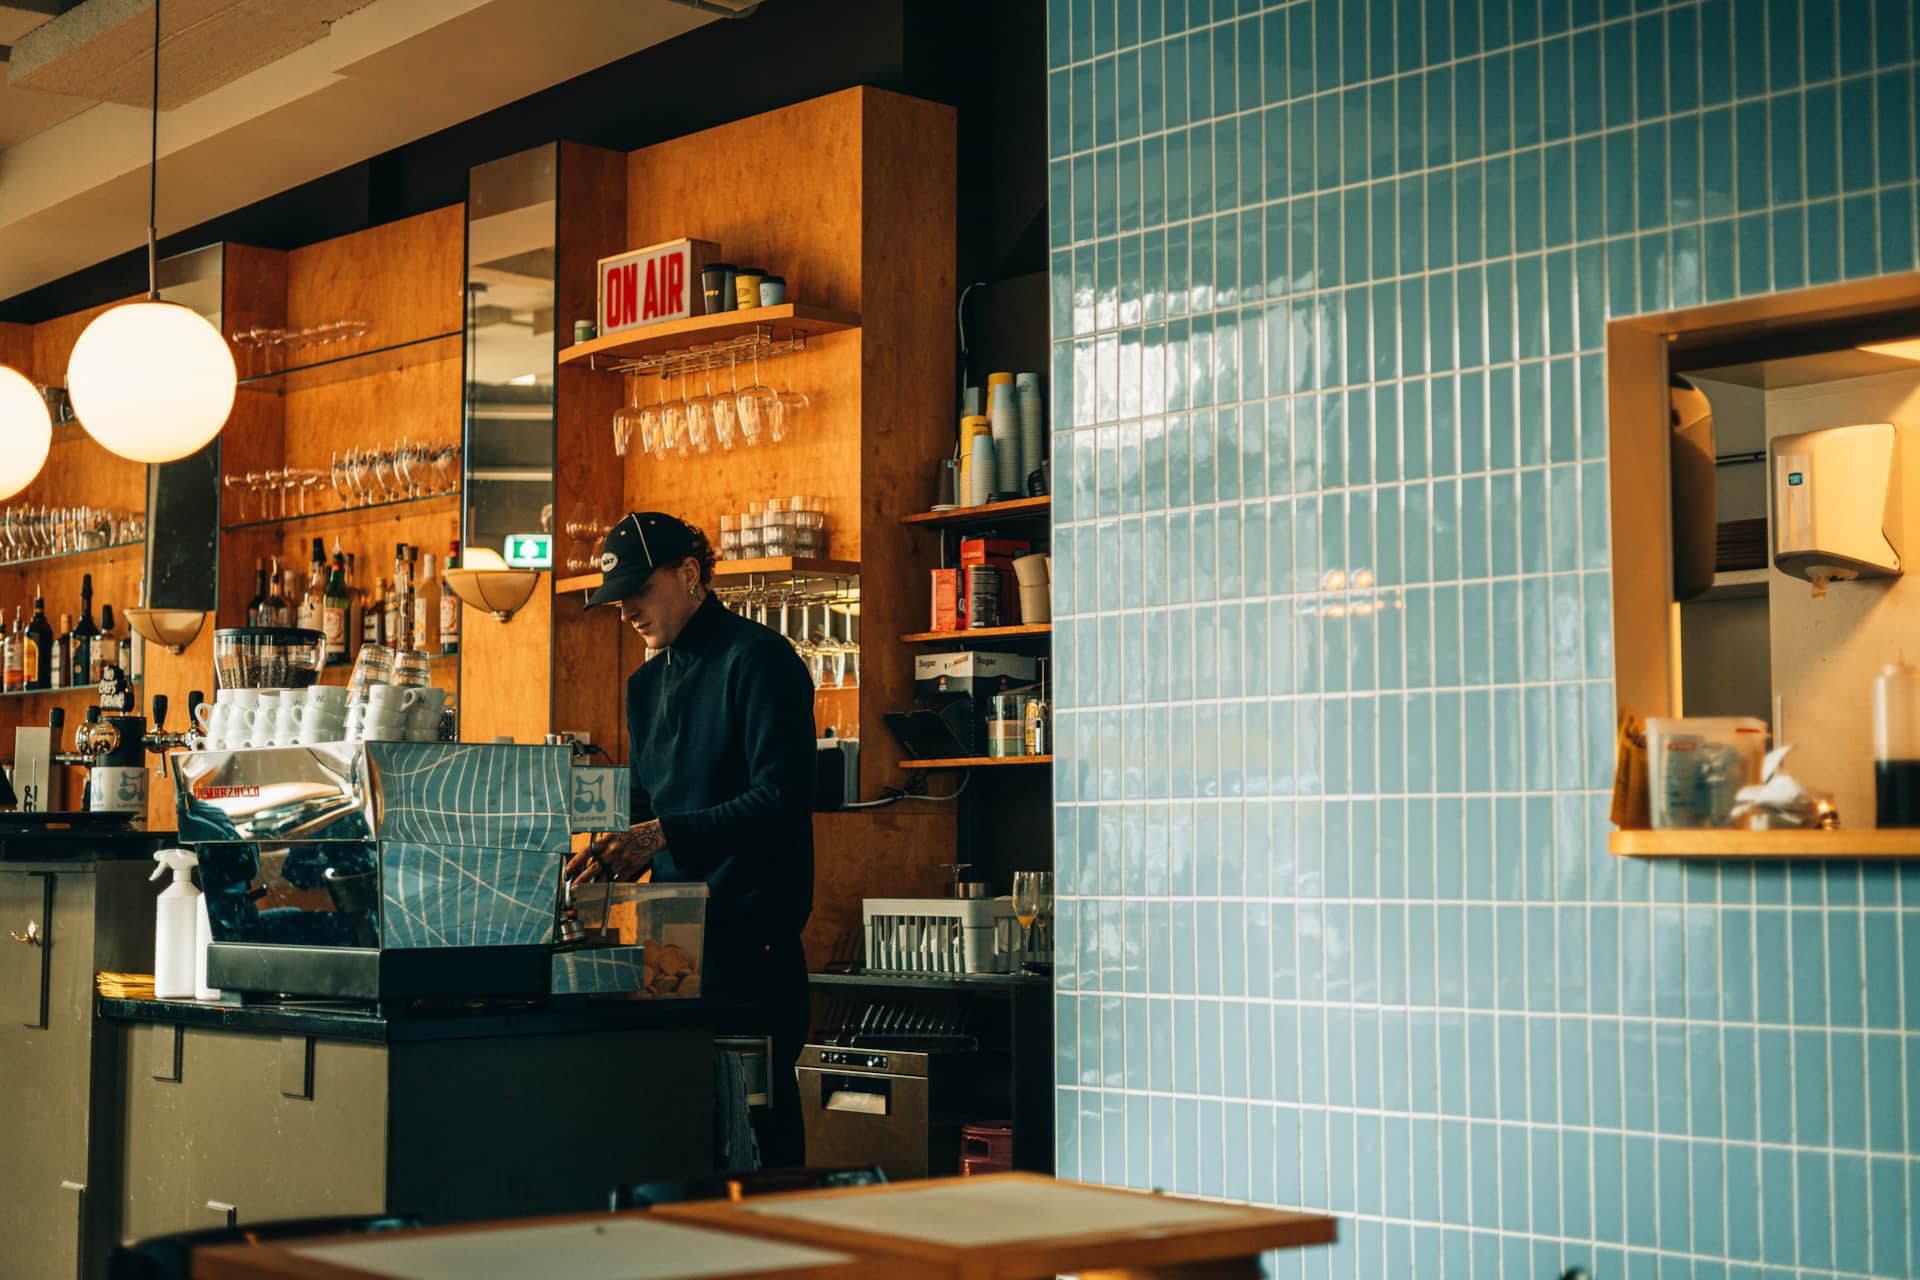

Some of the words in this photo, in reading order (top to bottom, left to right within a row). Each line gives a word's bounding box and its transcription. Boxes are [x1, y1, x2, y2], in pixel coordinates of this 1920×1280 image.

[606, 263, 638, 328] ON
[642, 252, 684, 320] AIR
[919, 659, 937, 669] Sugar
[976, 655, 997, 667] Sugar
